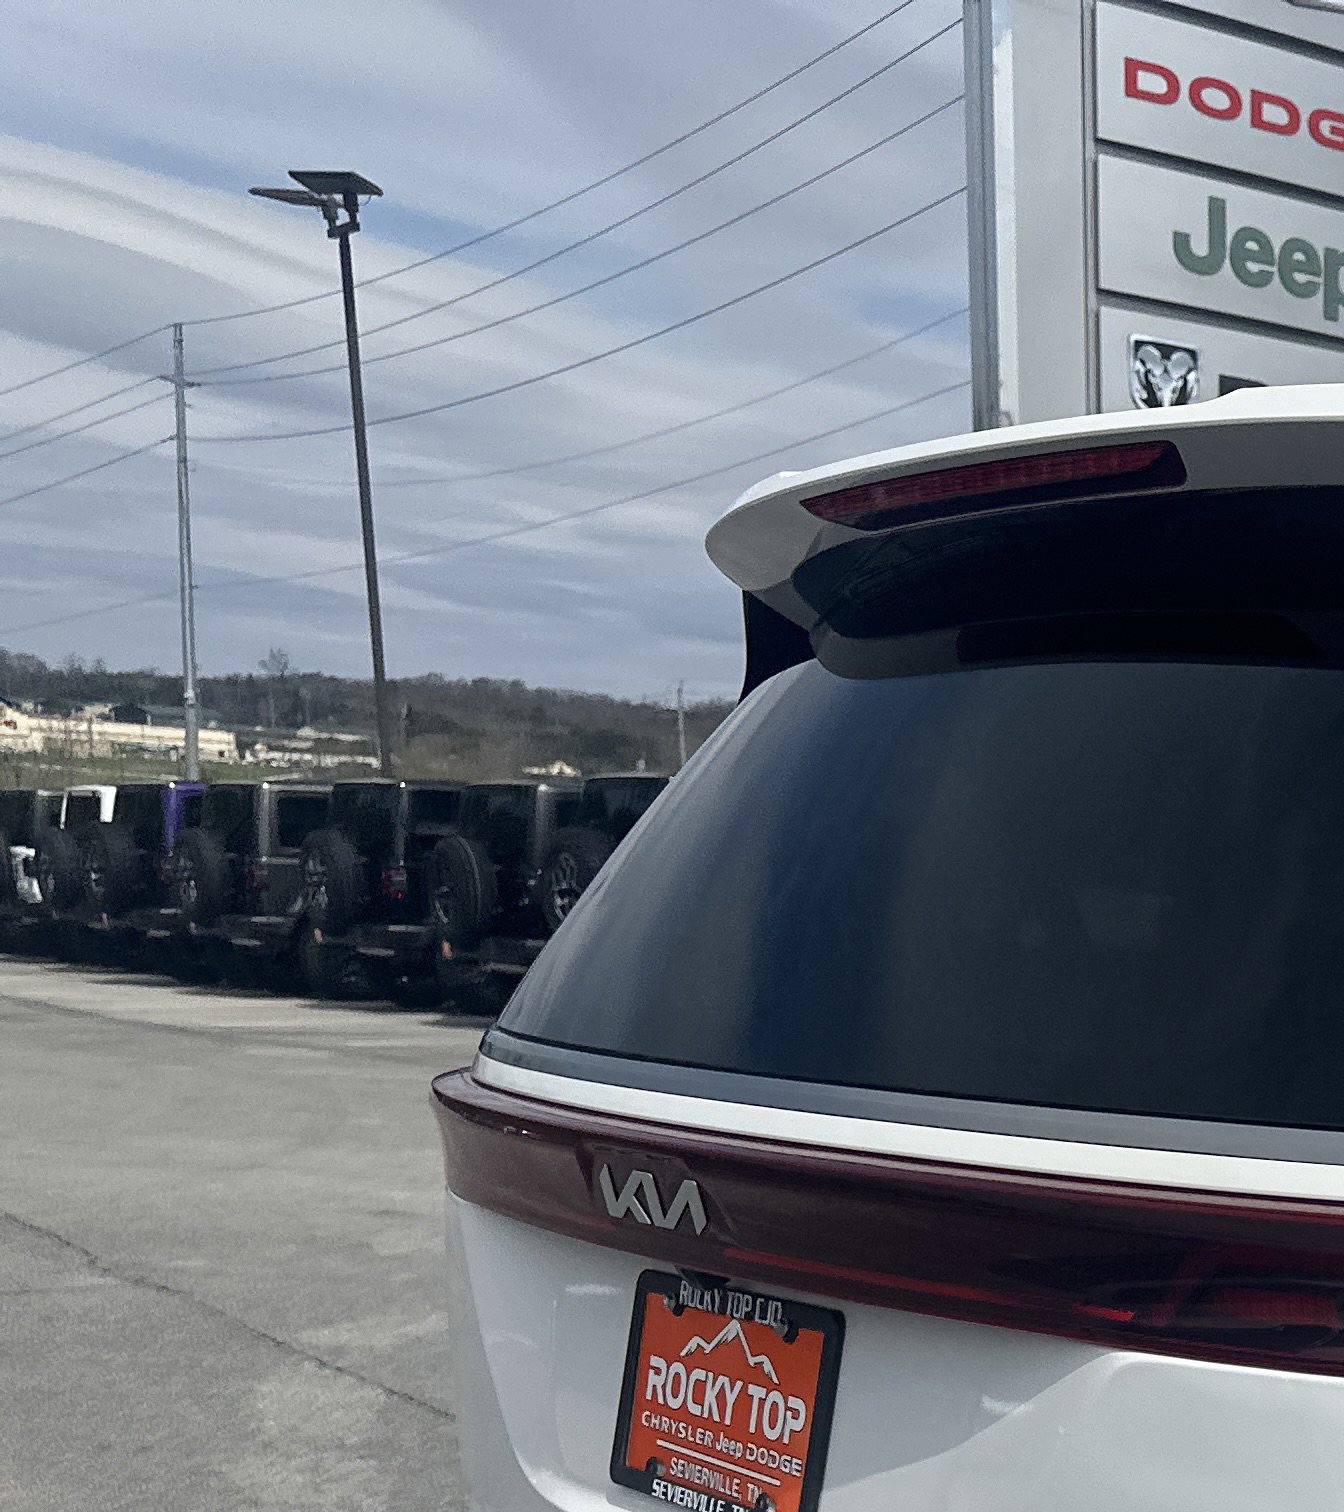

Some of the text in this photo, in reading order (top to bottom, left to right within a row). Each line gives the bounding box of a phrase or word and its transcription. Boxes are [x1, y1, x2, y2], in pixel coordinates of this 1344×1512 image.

[599, 1163, 709, 1236] KIA
[726, 1291, 752, 1319] TOP
[645, 1354, 807, 1445] ROCKY TOP
[641, 1410, 803, 1477] CHRYSLER Jeep DODGE
